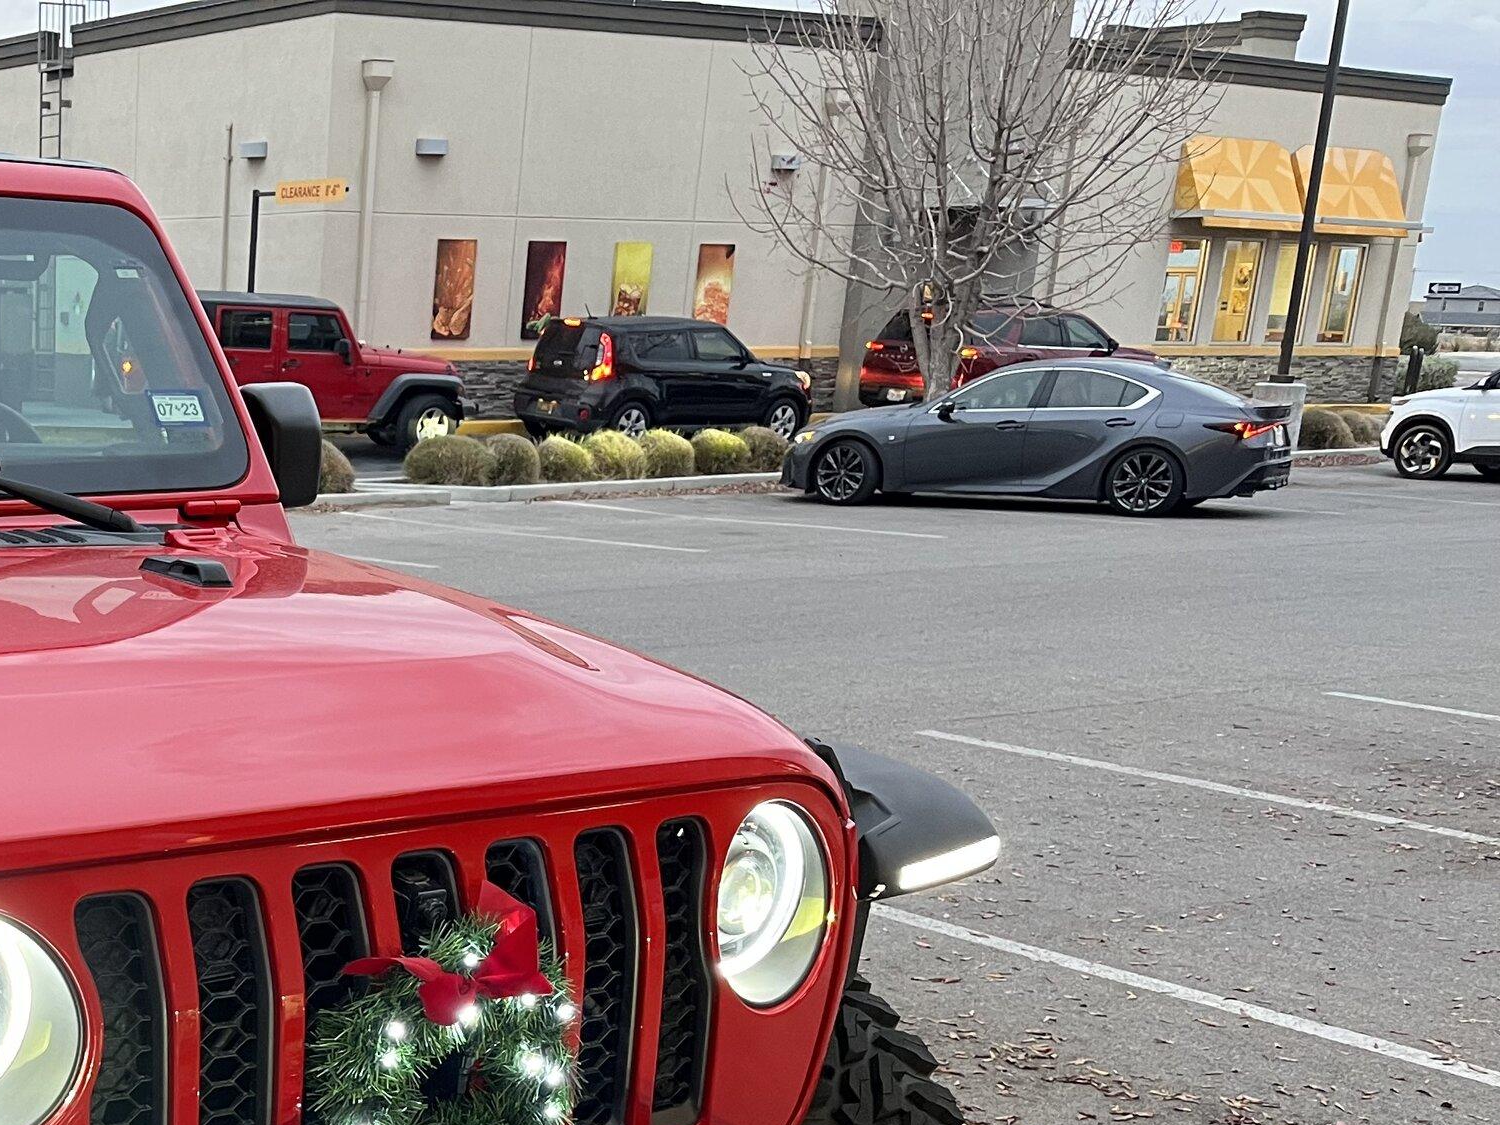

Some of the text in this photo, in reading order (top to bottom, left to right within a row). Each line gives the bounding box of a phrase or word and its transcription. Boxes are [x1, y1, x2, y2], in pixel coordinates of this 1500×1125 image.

[280, 185, 321, 199] CLEARANCE
[157, 402, 199, 416] 07 23
